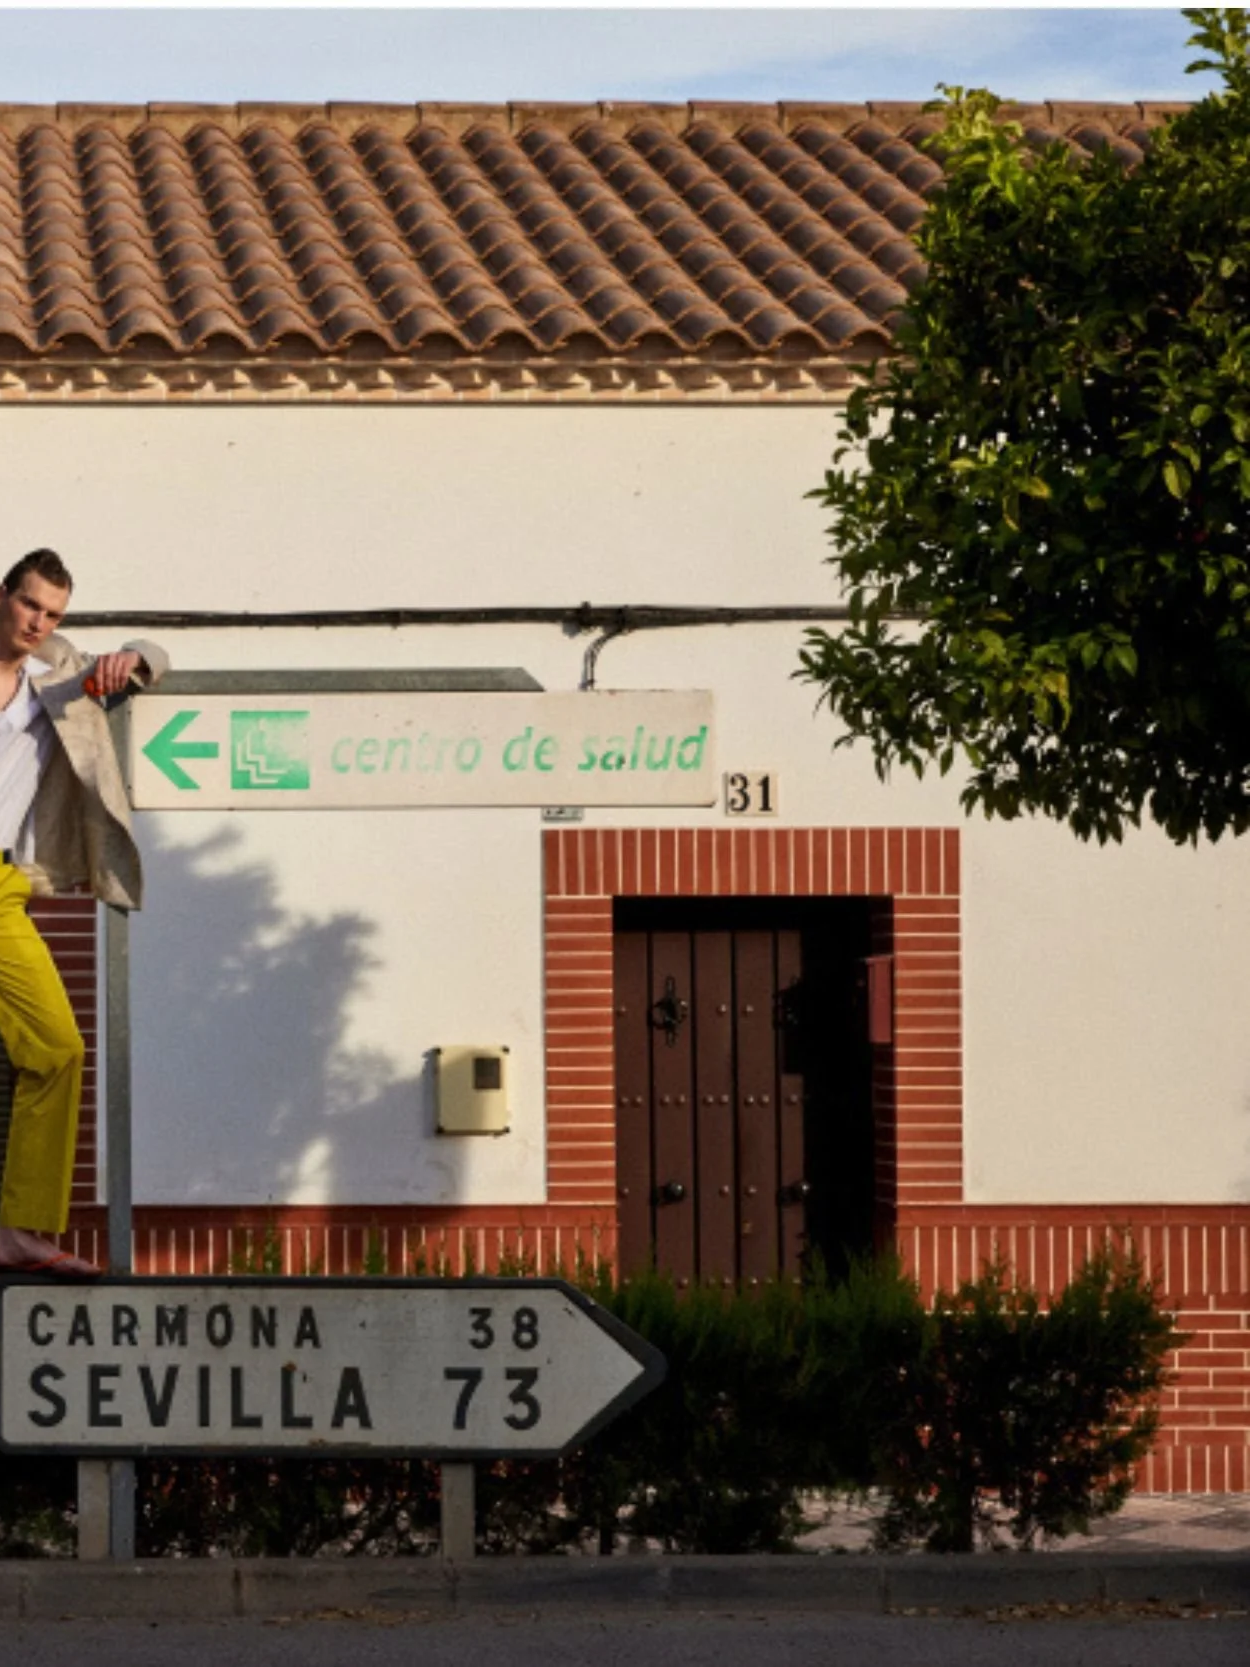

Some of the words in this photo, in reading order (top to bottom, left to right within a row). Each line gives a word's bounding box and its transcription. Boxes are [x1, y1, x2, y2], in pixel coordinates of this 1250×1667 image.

[331, 732, 484, 774] centro
[502, 726, 556, 773] de
[576, 724, 709, 773] salud
[729, 773, 773, 812] 31
[27, 1302, 322, 1348] CARMONA
[468, 1306, 540, 1350] 38
[27, 1362, 373, 1430] SEVILLA
[443, 1367, 541, 1430] 73
